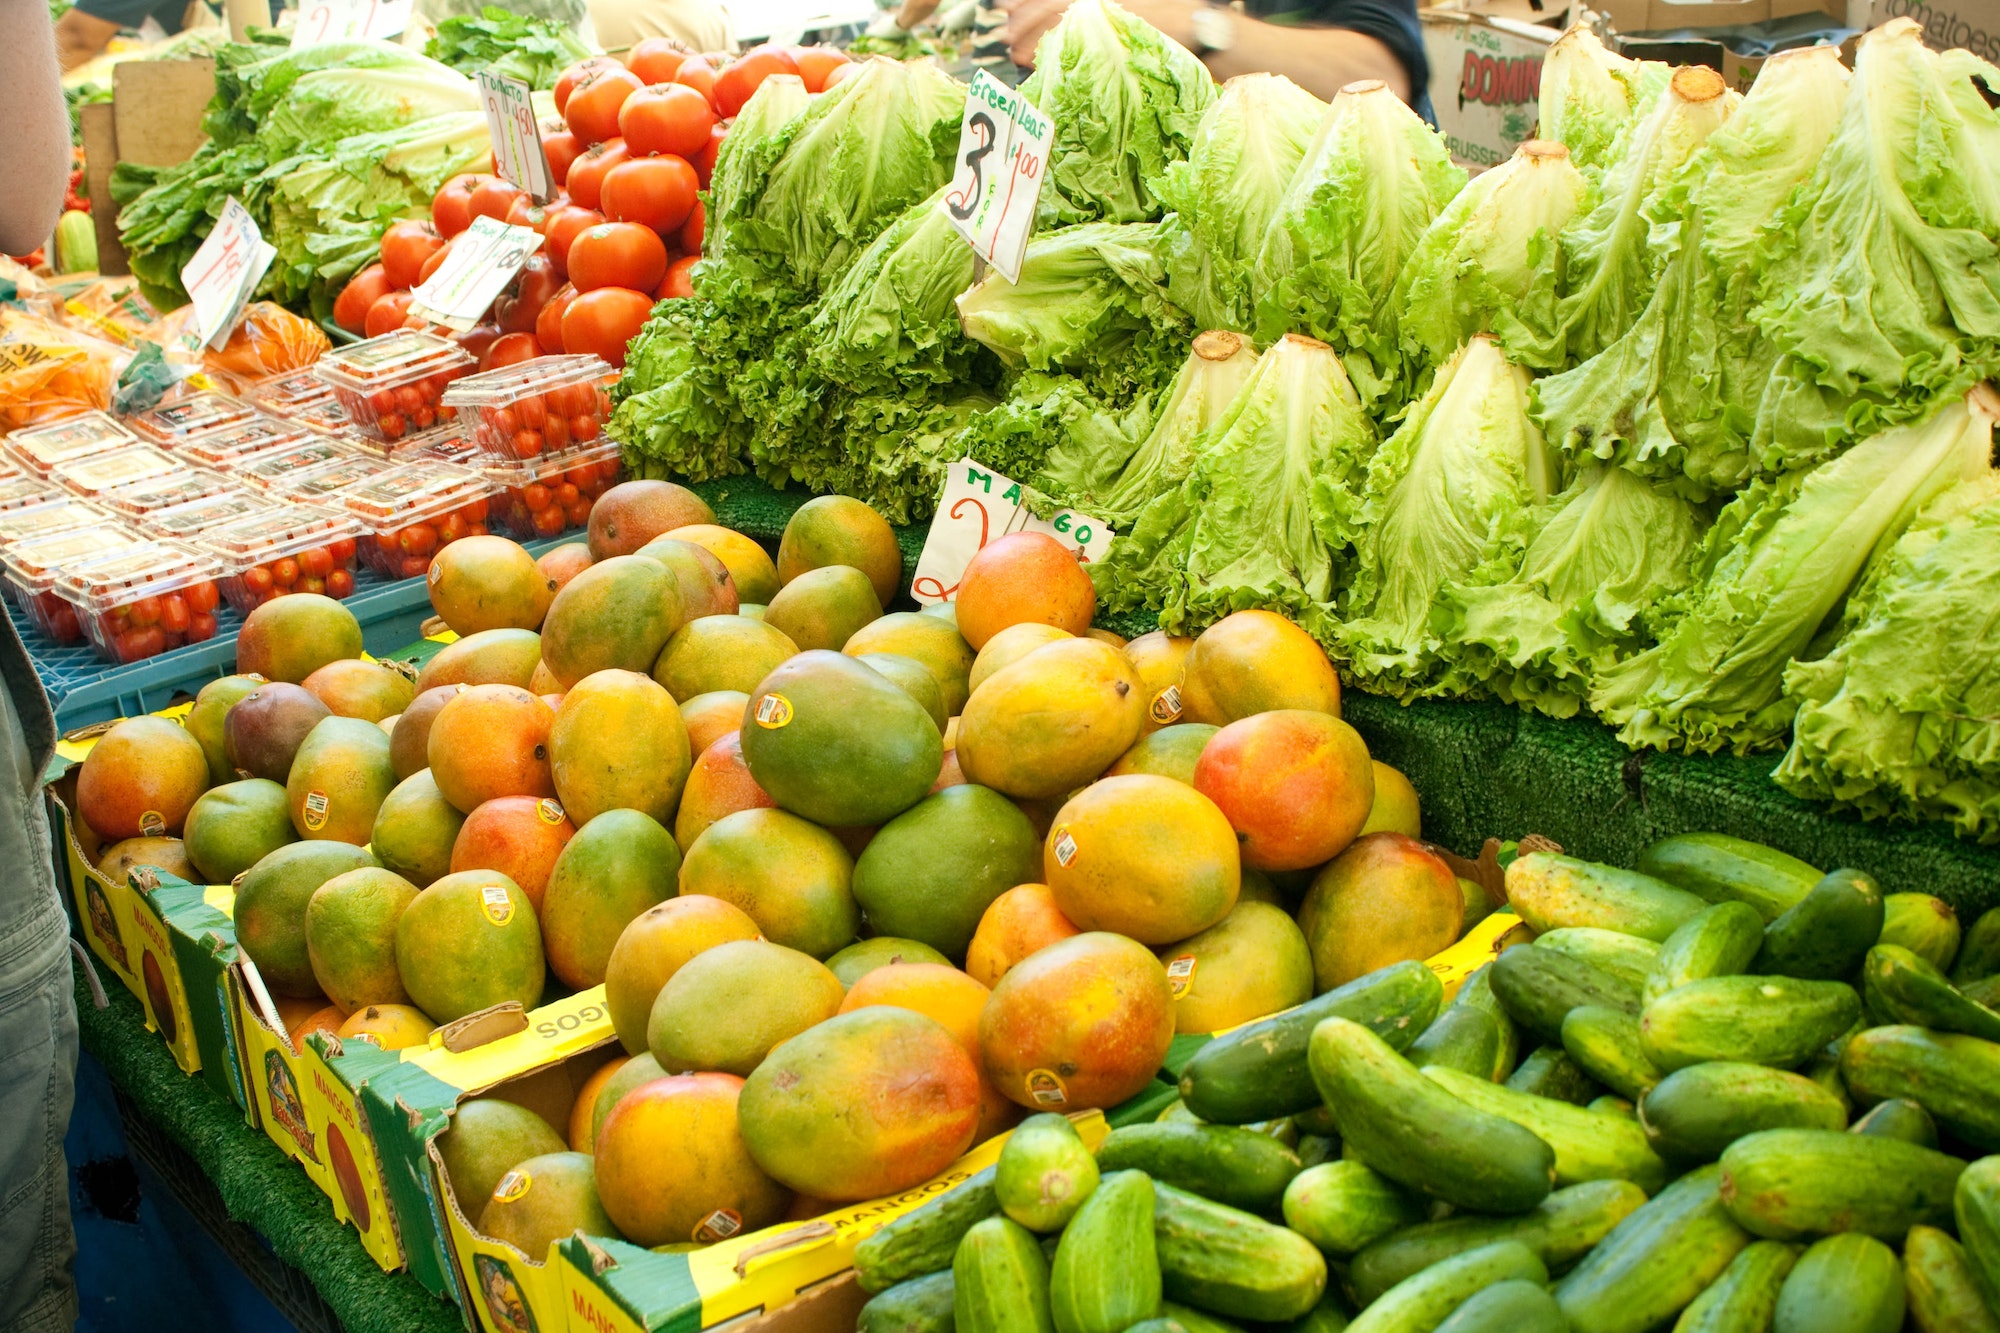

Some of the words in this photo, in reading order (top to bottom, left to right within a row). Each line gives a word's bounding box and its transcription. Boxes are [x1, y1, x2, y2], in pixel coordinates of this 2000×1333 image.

[970, 73, 1017, 120] Green
[966, 468, 1092, 545] MAGO
[133, 903, 168, 958] MANGOS
[536, 1001, 609, 1039] GOS
[313, 1068, 355, 1130] MANGOS
